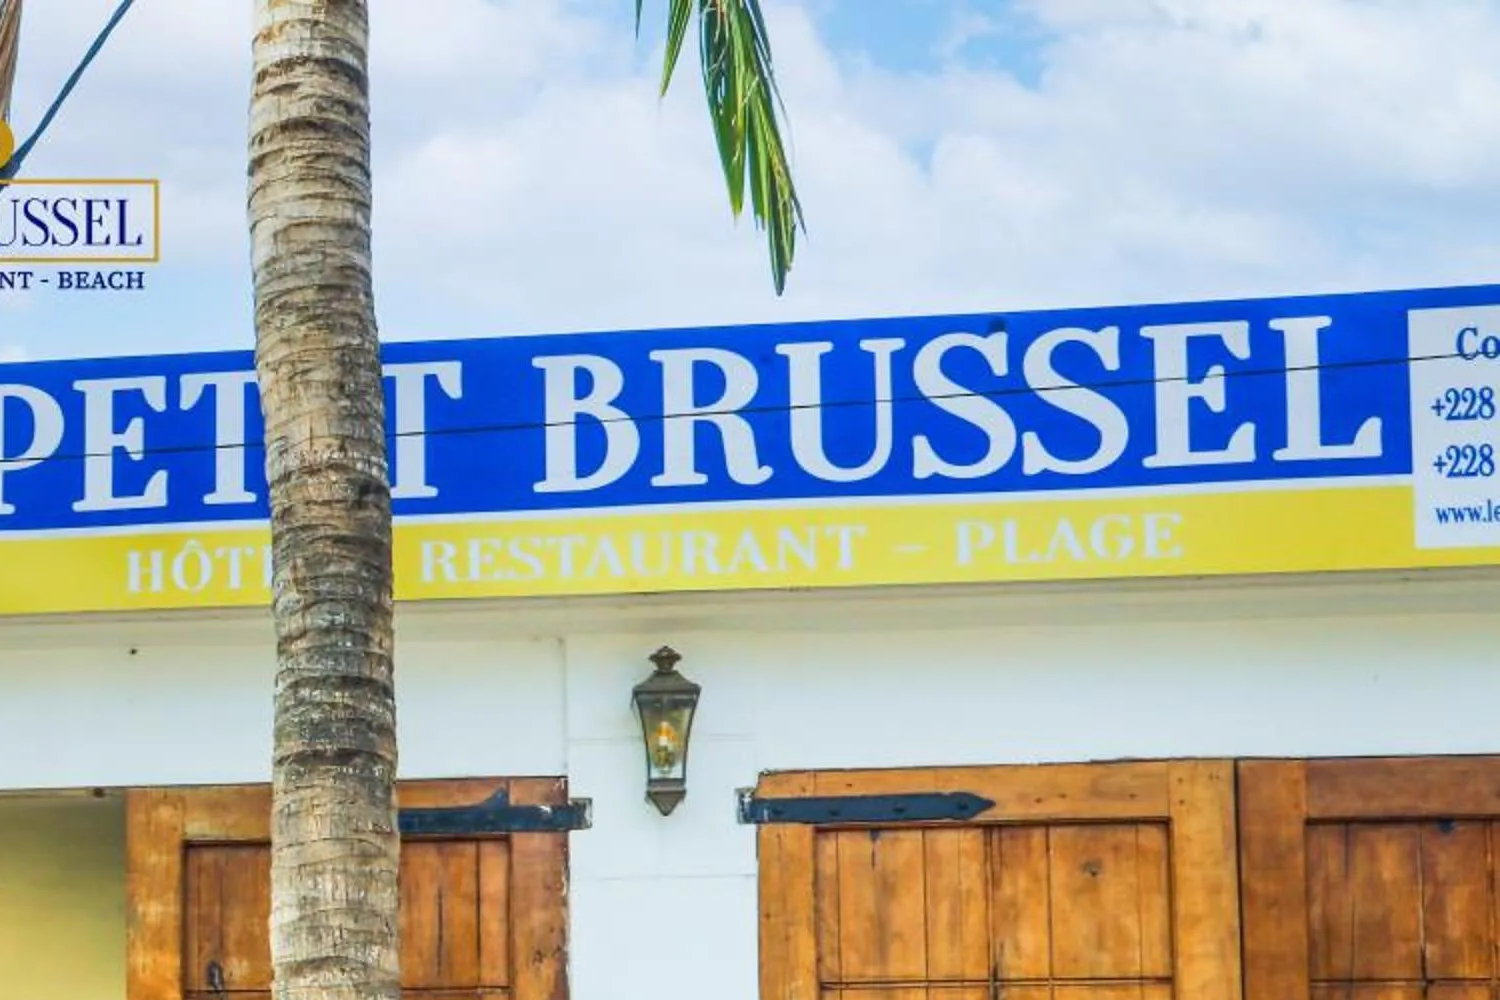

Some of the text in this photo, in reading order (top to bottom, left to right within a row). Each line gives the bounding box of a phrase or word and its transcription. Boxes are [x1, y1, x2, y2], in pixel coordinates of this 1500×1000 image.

[532, 314, 1383, 494] BRUSSEL
[1431, 387, 1495, 421] +228
[1433, 444, 1495, 478] +228
[126, 539, 272, 594] HÔT
[419, 524, 866, 583] RESTAURANT
[956, 511, 1185, 567] PLAGE
